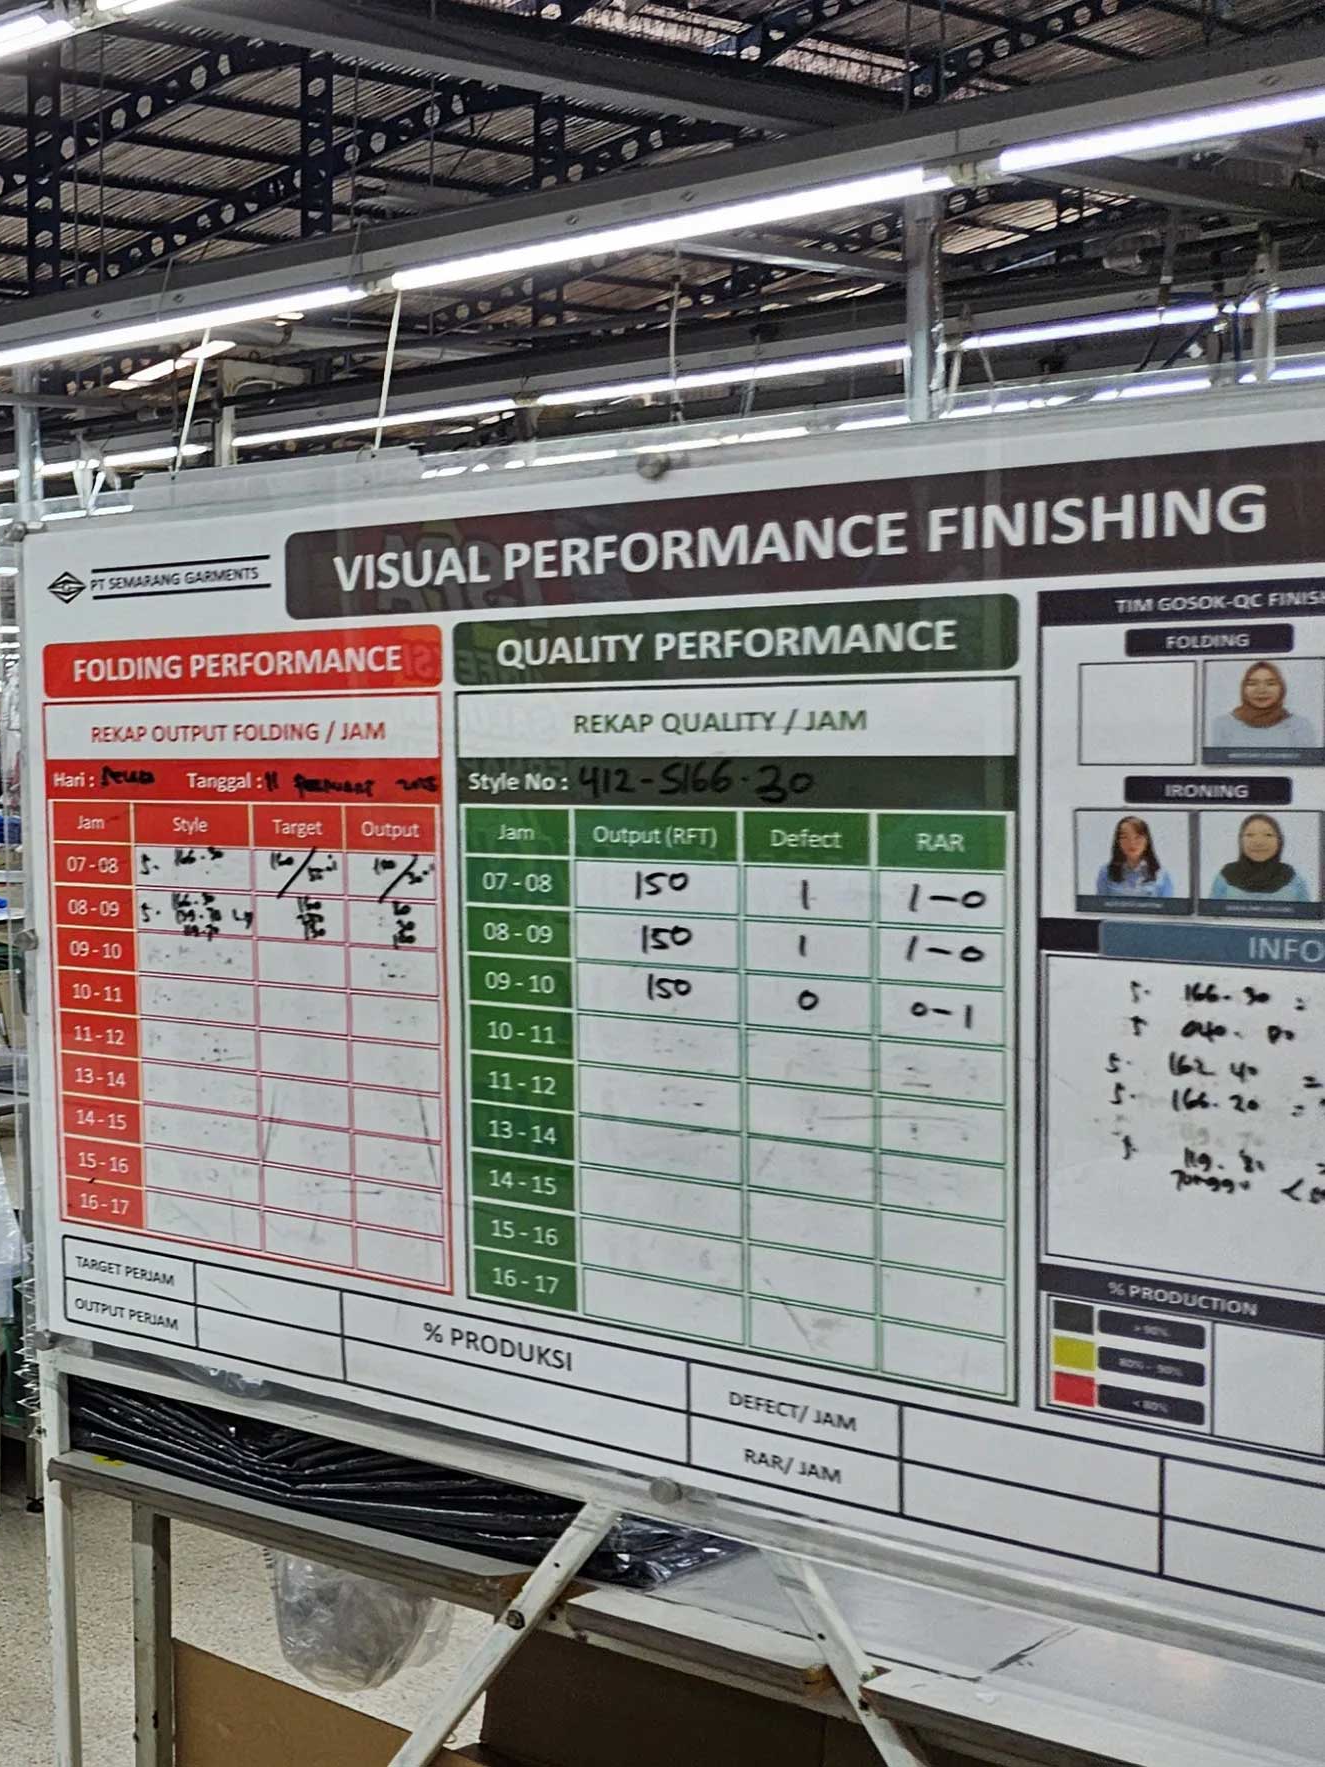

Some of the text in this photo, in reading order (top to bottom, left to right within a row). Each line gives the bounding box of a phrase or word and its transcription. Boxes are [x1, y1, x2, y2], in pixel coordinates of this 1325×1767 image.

[332, 483, 1269, 592] VISUAL PERFORMANCE FINISHING
[90, 567, 259, 591] PT SEMARANG GARMENTS
[1115, 599, 1153, 614] TIM
[496, 619, 959, 671] QUALITY PERFORMANCE
[1165, 633, 1250, 649] FOLDING
[73, 645, 404, 683] FOLDING PERFORMANCE
[91, 726, 147, 744] REKAP
[152, 724, 227, 743] OUTPUT
[233, 722, 320, 742] FOLDING
[340, 721, 386, 741] JAM
[574, 713, 653, 734] REKAP
[661, 711, 778, 736] QUALITY
[804, 710, 868, 732] JAM
[53, 773, 85, 788] Hari
[186, 772, 252, 794] Tanggal
[468, 772, 519, 795] Style
[1165, 784, 1249, 798] IRONING
[77, 815, 105, 831] Jam
[172, 815, 208, 836] Style
[272, 818, 324, 838] Target
[361, 821, 420, 840] Output
[497, 825, 535, 842] Jam
[592, 825, 718, 850] Output (RFT)
[770, 830, 843, 850] Defect
[915, 832, 965, 852] RAR
[635, 870, 689, 900] 150
[642, 924, 692, 953] 150
[647, 973, 692, 1000] 150
[75, 1255, 175, 1286] TARGET PERJAM
[1107, 1281, 1258, 1317] % PRODUCTION
[75, 1298, 179, 1331] OUTPUT PERJAM
[423, 1321, 573, 1372] % PRODUKSI
[812, 1409, 857, 1432] JAM
[798, 1461, 842, 1485] JAM
